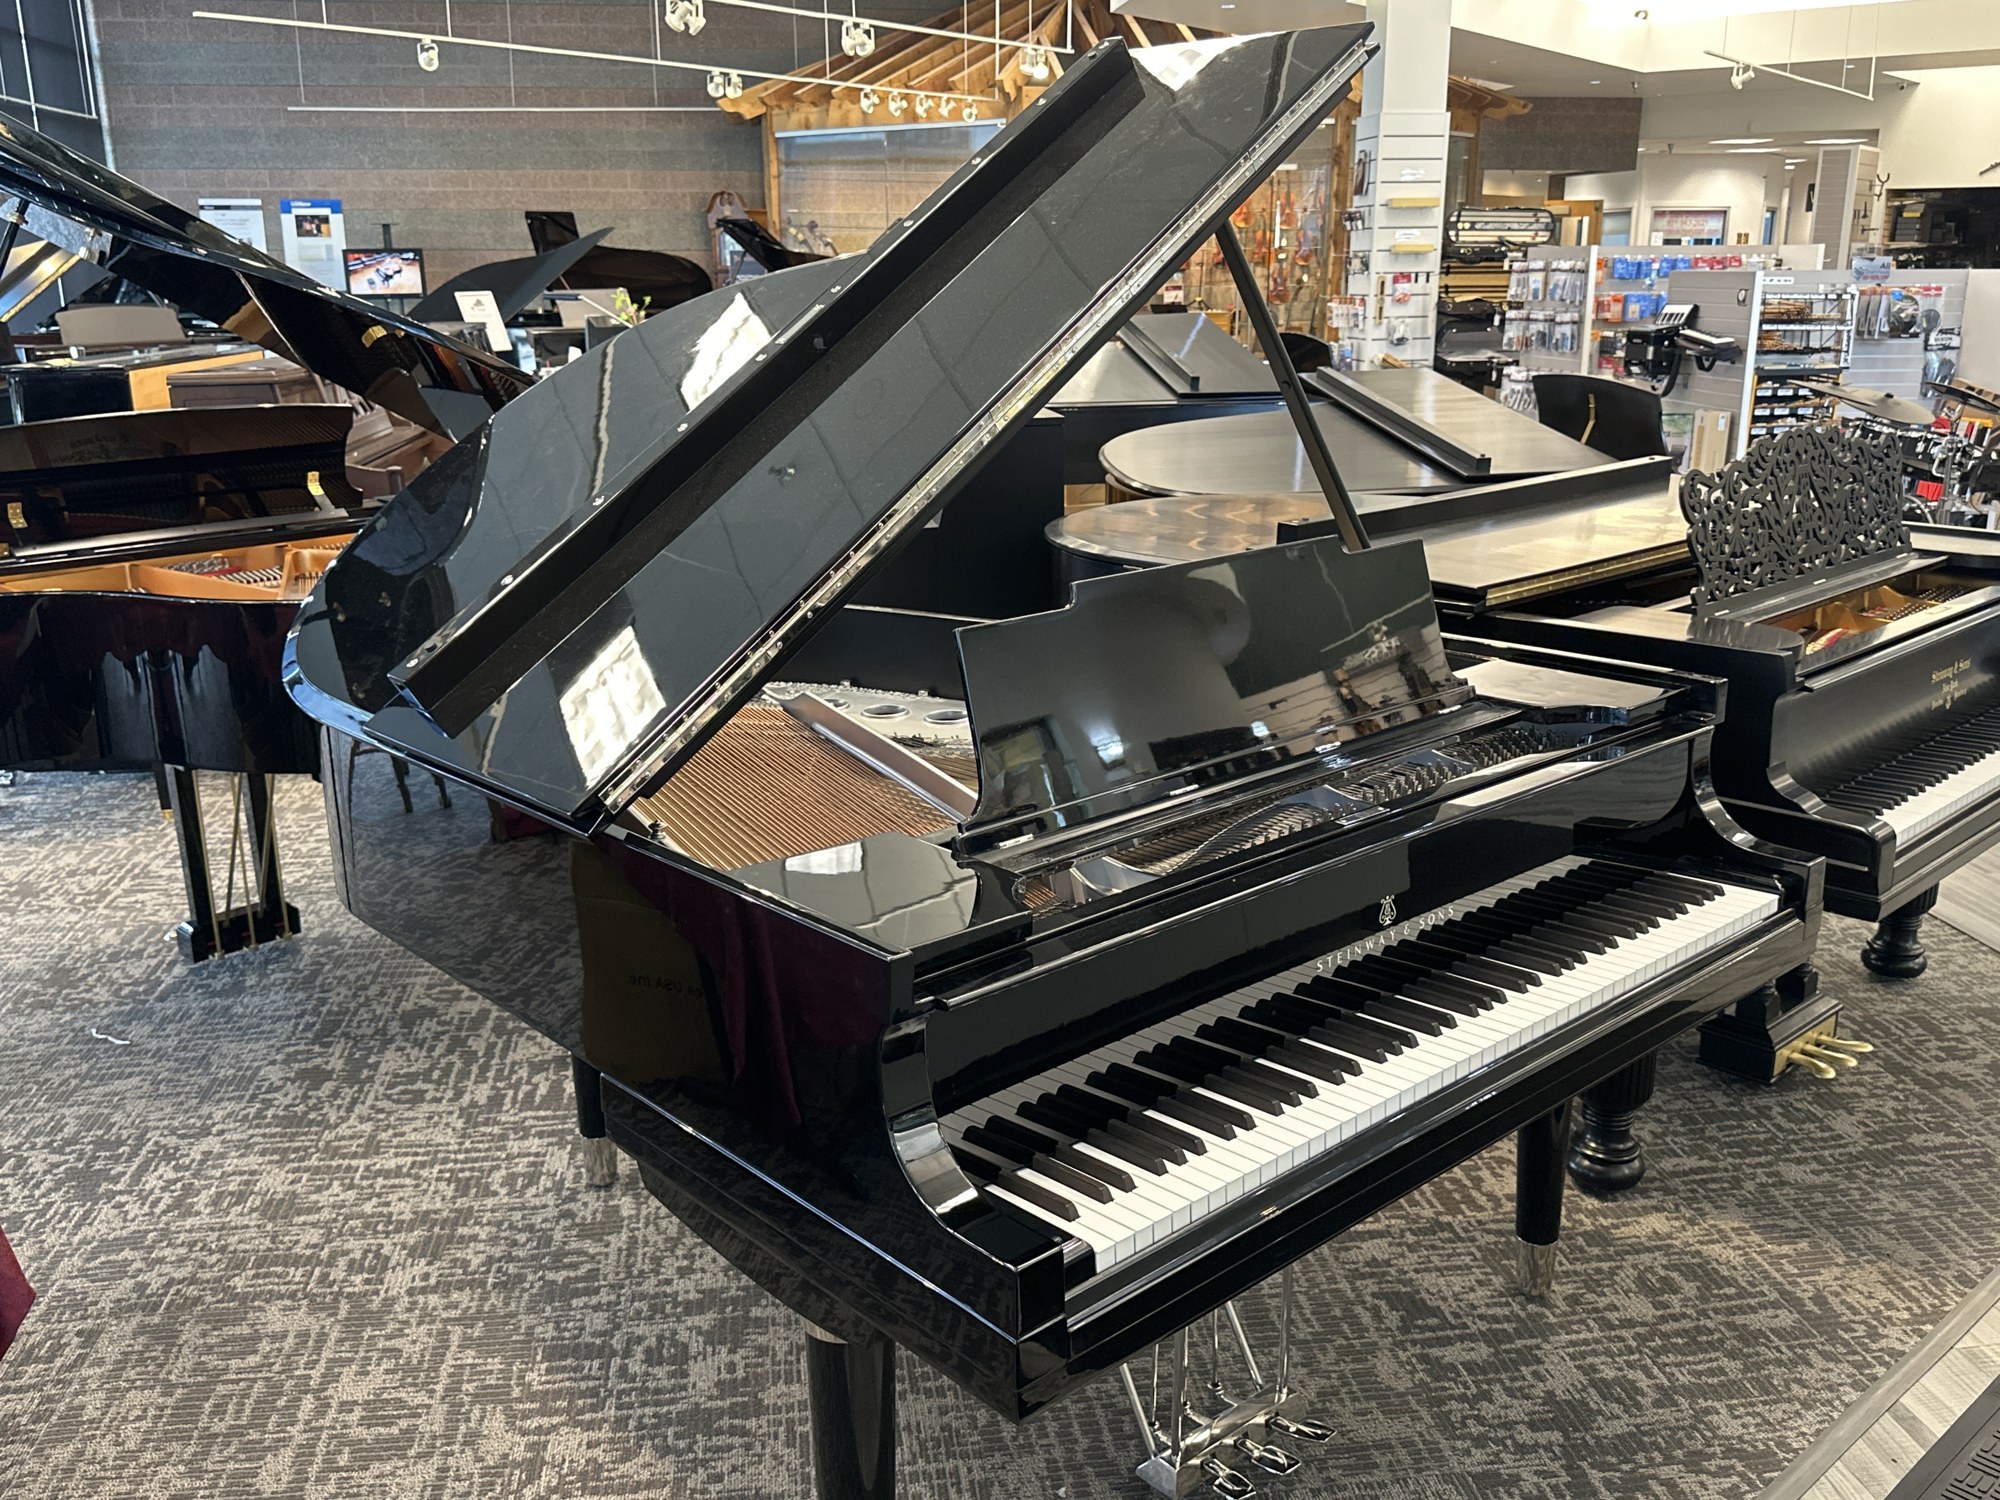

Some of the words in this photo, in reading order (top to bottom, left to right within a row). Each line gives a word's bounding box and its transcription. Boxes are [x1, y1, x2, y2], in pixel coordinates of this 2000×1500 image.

[1316, 929, 1396, 972] STEINWAY
[1403, 924, 1411, 936] &
[1419, 905, 1455, 929] SONS
